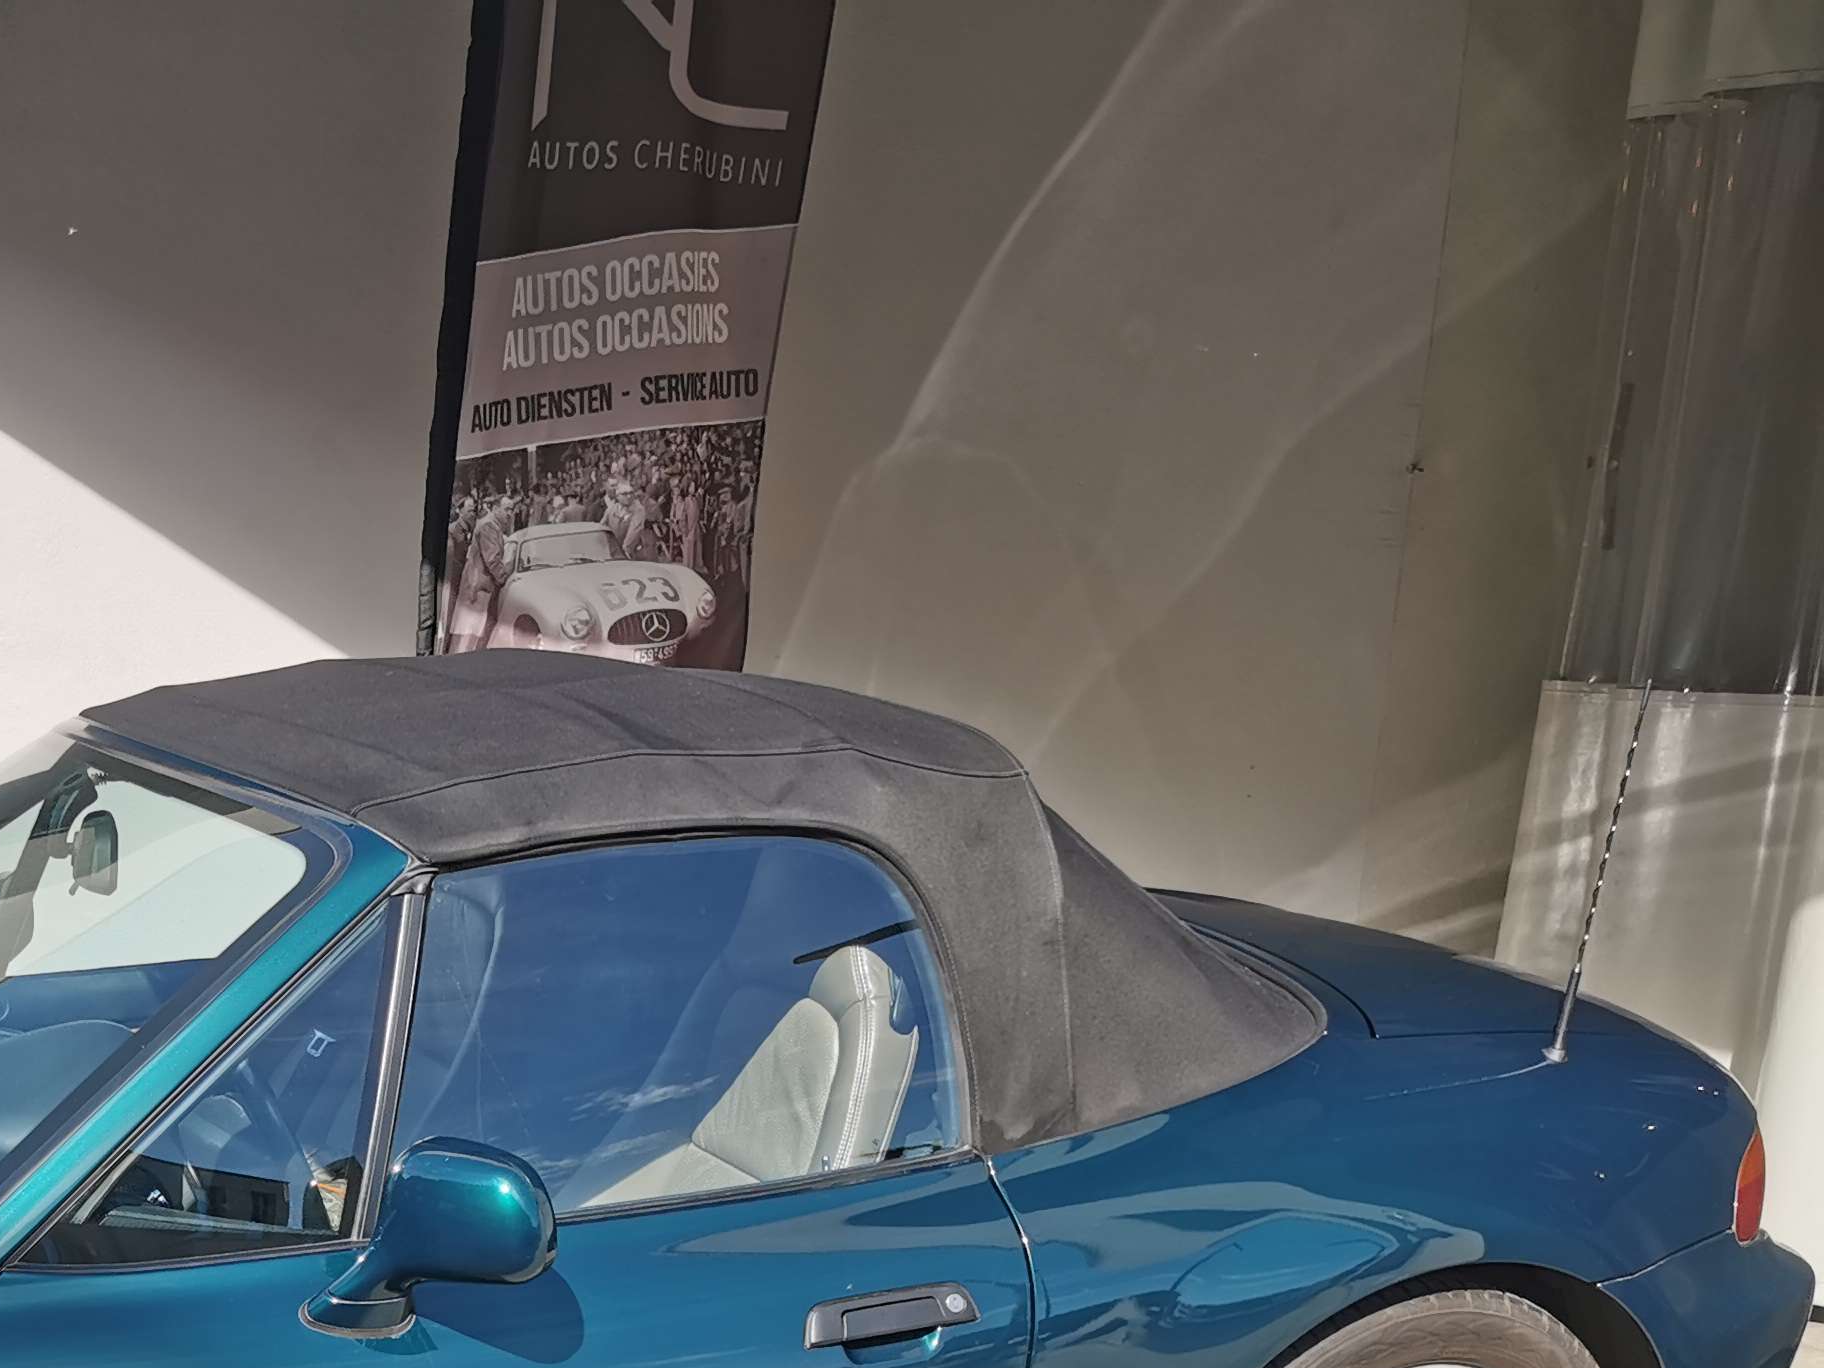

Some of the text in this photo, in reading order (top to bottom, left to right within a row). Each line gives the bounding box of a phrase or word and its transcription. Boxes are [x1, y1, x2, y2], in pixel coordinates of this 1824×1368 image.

[527, 139, 783, 187] AUTOS CHERUBINI
[511, 250, 720, 318] AUTOS OCCASIES
[502, 303, 729, 371] AUTOS OCCASIONS
[470, 398, 512, 433] AUTO
[516, 382, 613, 425] DIENSTEN
[709, 368, 759, 400] AUTO
